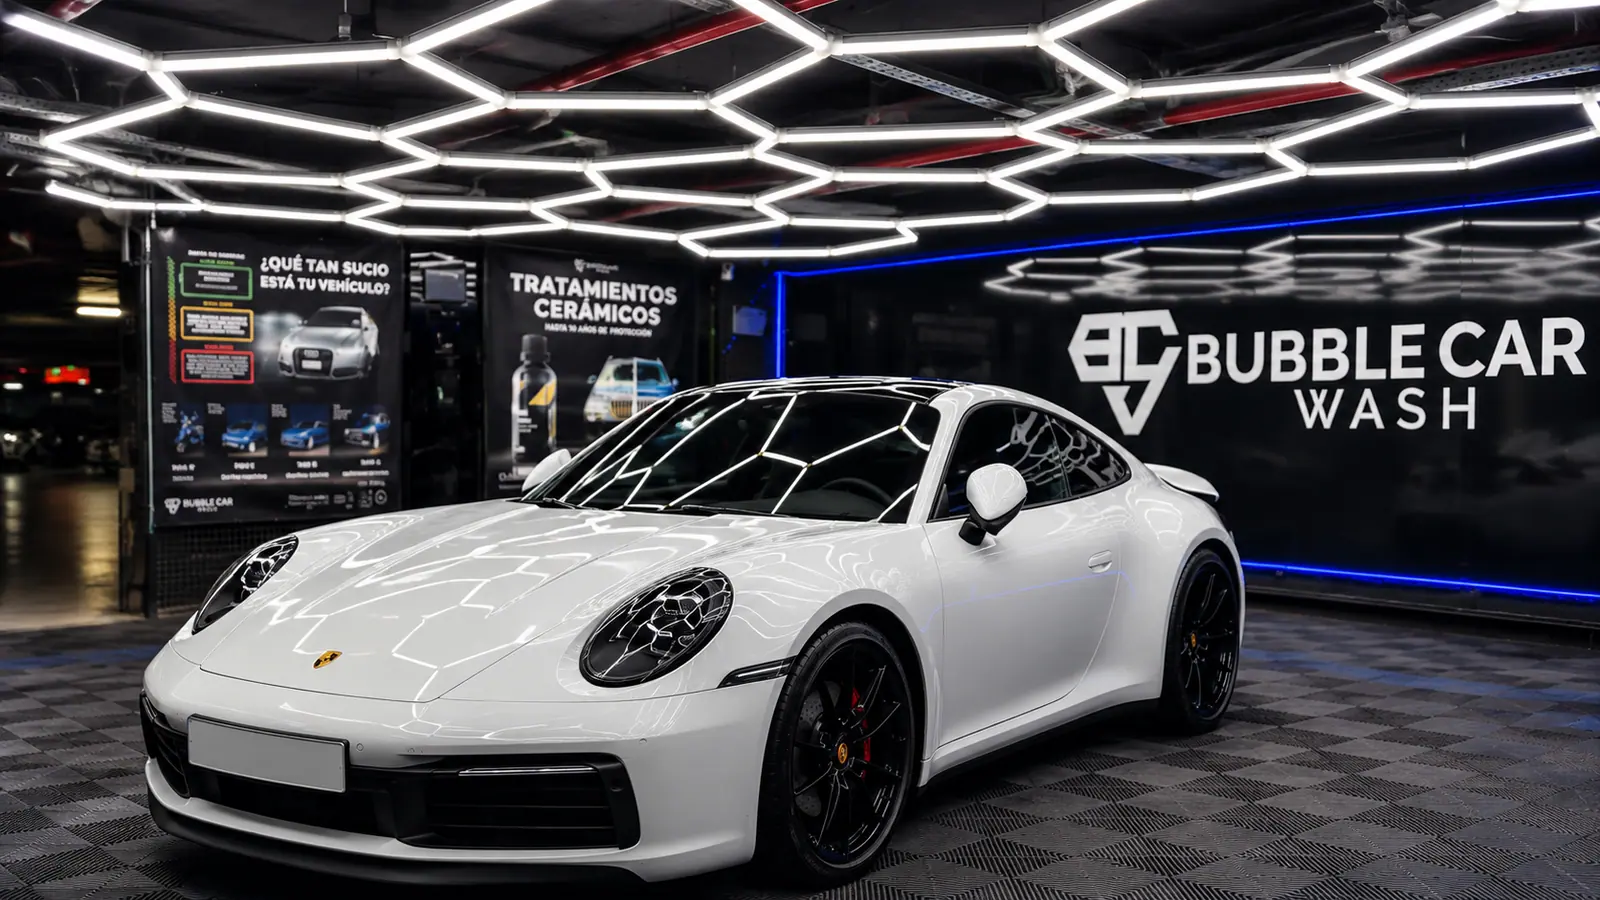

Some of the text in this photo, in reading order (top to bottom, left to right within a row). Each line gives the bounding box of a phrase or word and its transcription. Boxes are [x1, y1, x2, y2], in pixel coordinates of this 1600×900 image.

[260, 254, 303, 272] ¿QUÉ
[305, 258, 339, 274] TAN
[342, 261, 389, 277] SUCIO
[260, 273, 391, 295] ESTÁ TU VEHÍCULO?
[510, 272, 678, 306] TRATAMIENTOS
[533, 297, 662, 326] CERÁMICOS
[544, 322, 568, 332] HASTA
[578, 324, 598, 334] AÑOS
[598, 326, 608, 335] DE
[609, 326, 653, 338] PROTECCIÓN
[1187, 316, 1588, 385] BUBBLE CAR
[1293, 386, 1477, 431] WASH
[182, 497, 234, 508] BUBBLE CAR
